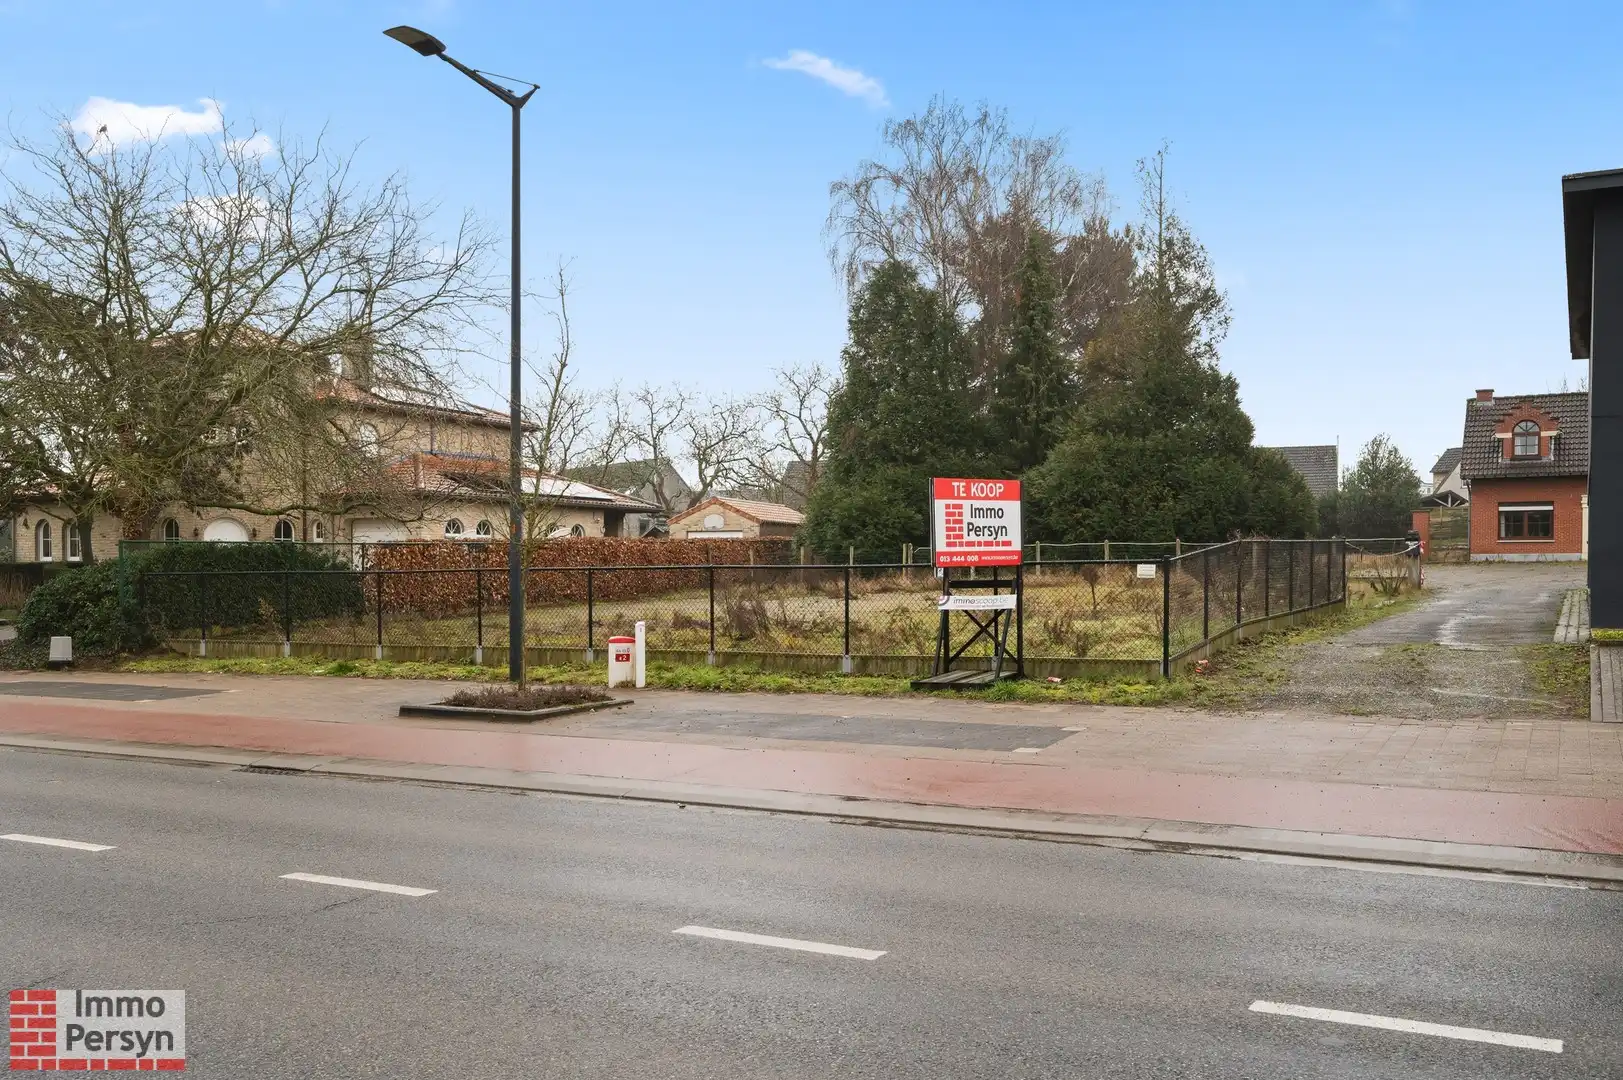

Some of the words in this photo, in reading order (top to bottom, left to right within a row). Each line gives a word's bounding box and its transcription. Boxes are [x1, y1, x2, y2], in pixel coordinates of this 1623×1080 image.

[952, 482, 966, 497] TE
[971, 483, 1004, 497] KOOP
[970, 504, 1004, 518] Immo
[967, 522, 1008, 540] Persyn
